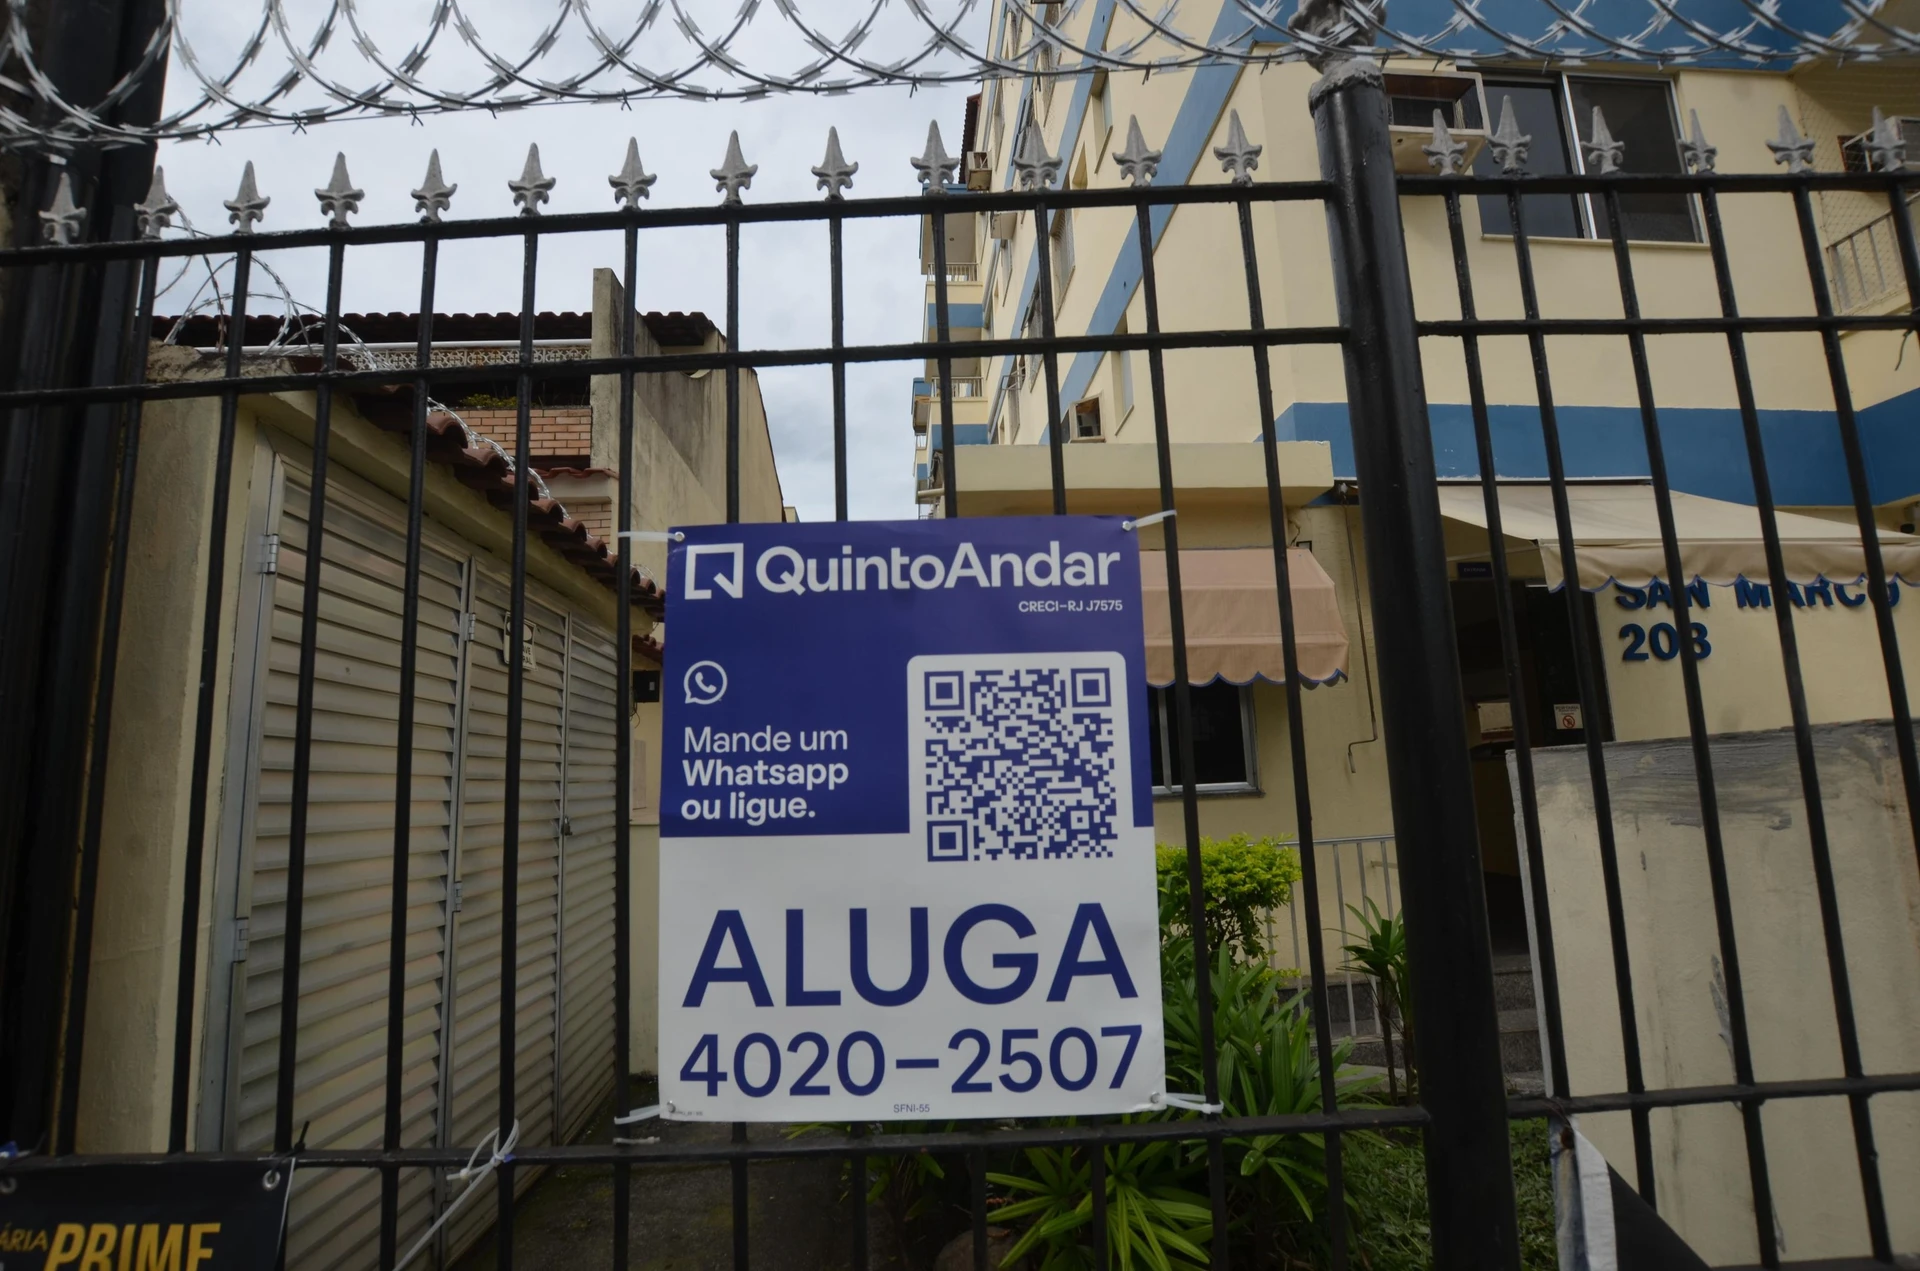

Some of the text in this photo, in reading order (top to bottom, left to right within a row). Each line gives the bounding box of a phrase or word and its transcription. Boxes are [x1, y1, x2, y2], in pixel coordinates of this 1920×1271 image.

[756, 541, 1121, 596] QuintoAndar
[1018, 600, 1123, 612] CRECI-RJ J7575
[1614, 577, 1710, 609] SAN
[684, 724, 848, 753] Mande um
[682, 758, 849, 791] Whatsapp
[681, 791, 816, 826] ou ligue.
[681, 902, 1139, 1007] ALUGA
[679, 1024, 1143, 1098] 4020-2507
[893, 1103, 931, 1113] SFNI-55
